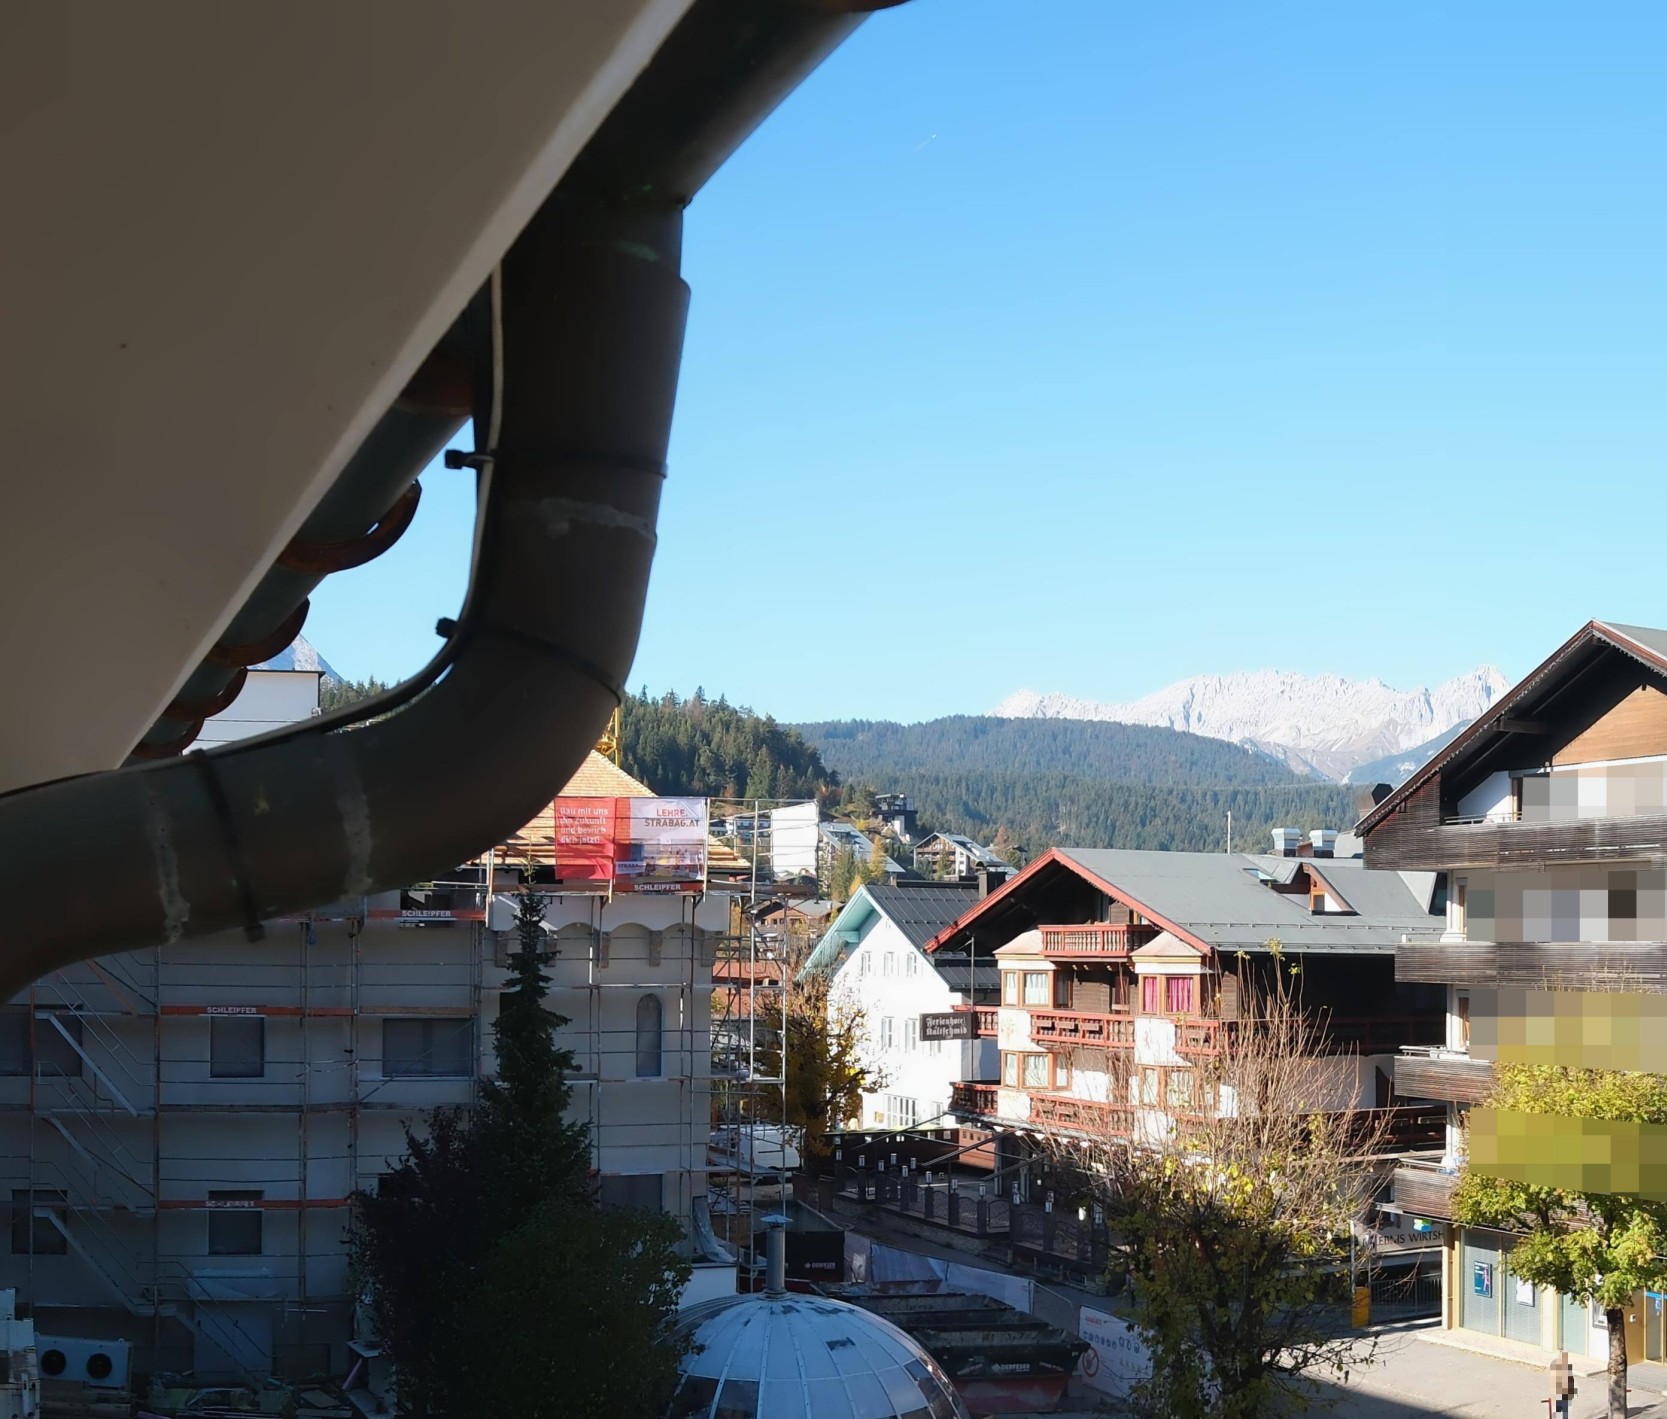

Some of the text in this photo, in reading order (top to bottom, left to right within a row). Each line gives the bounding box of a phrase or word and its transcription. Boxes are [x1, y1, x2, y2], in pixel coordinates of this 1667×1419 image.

[656, 808, 688, 818] LEHRE.
[644, 818, 700, 828] STRABAG.AT
[401, 909, 452, 917] SCHLEIPFER
[206, 1006, 257, 1014] SCHLEIPFER
